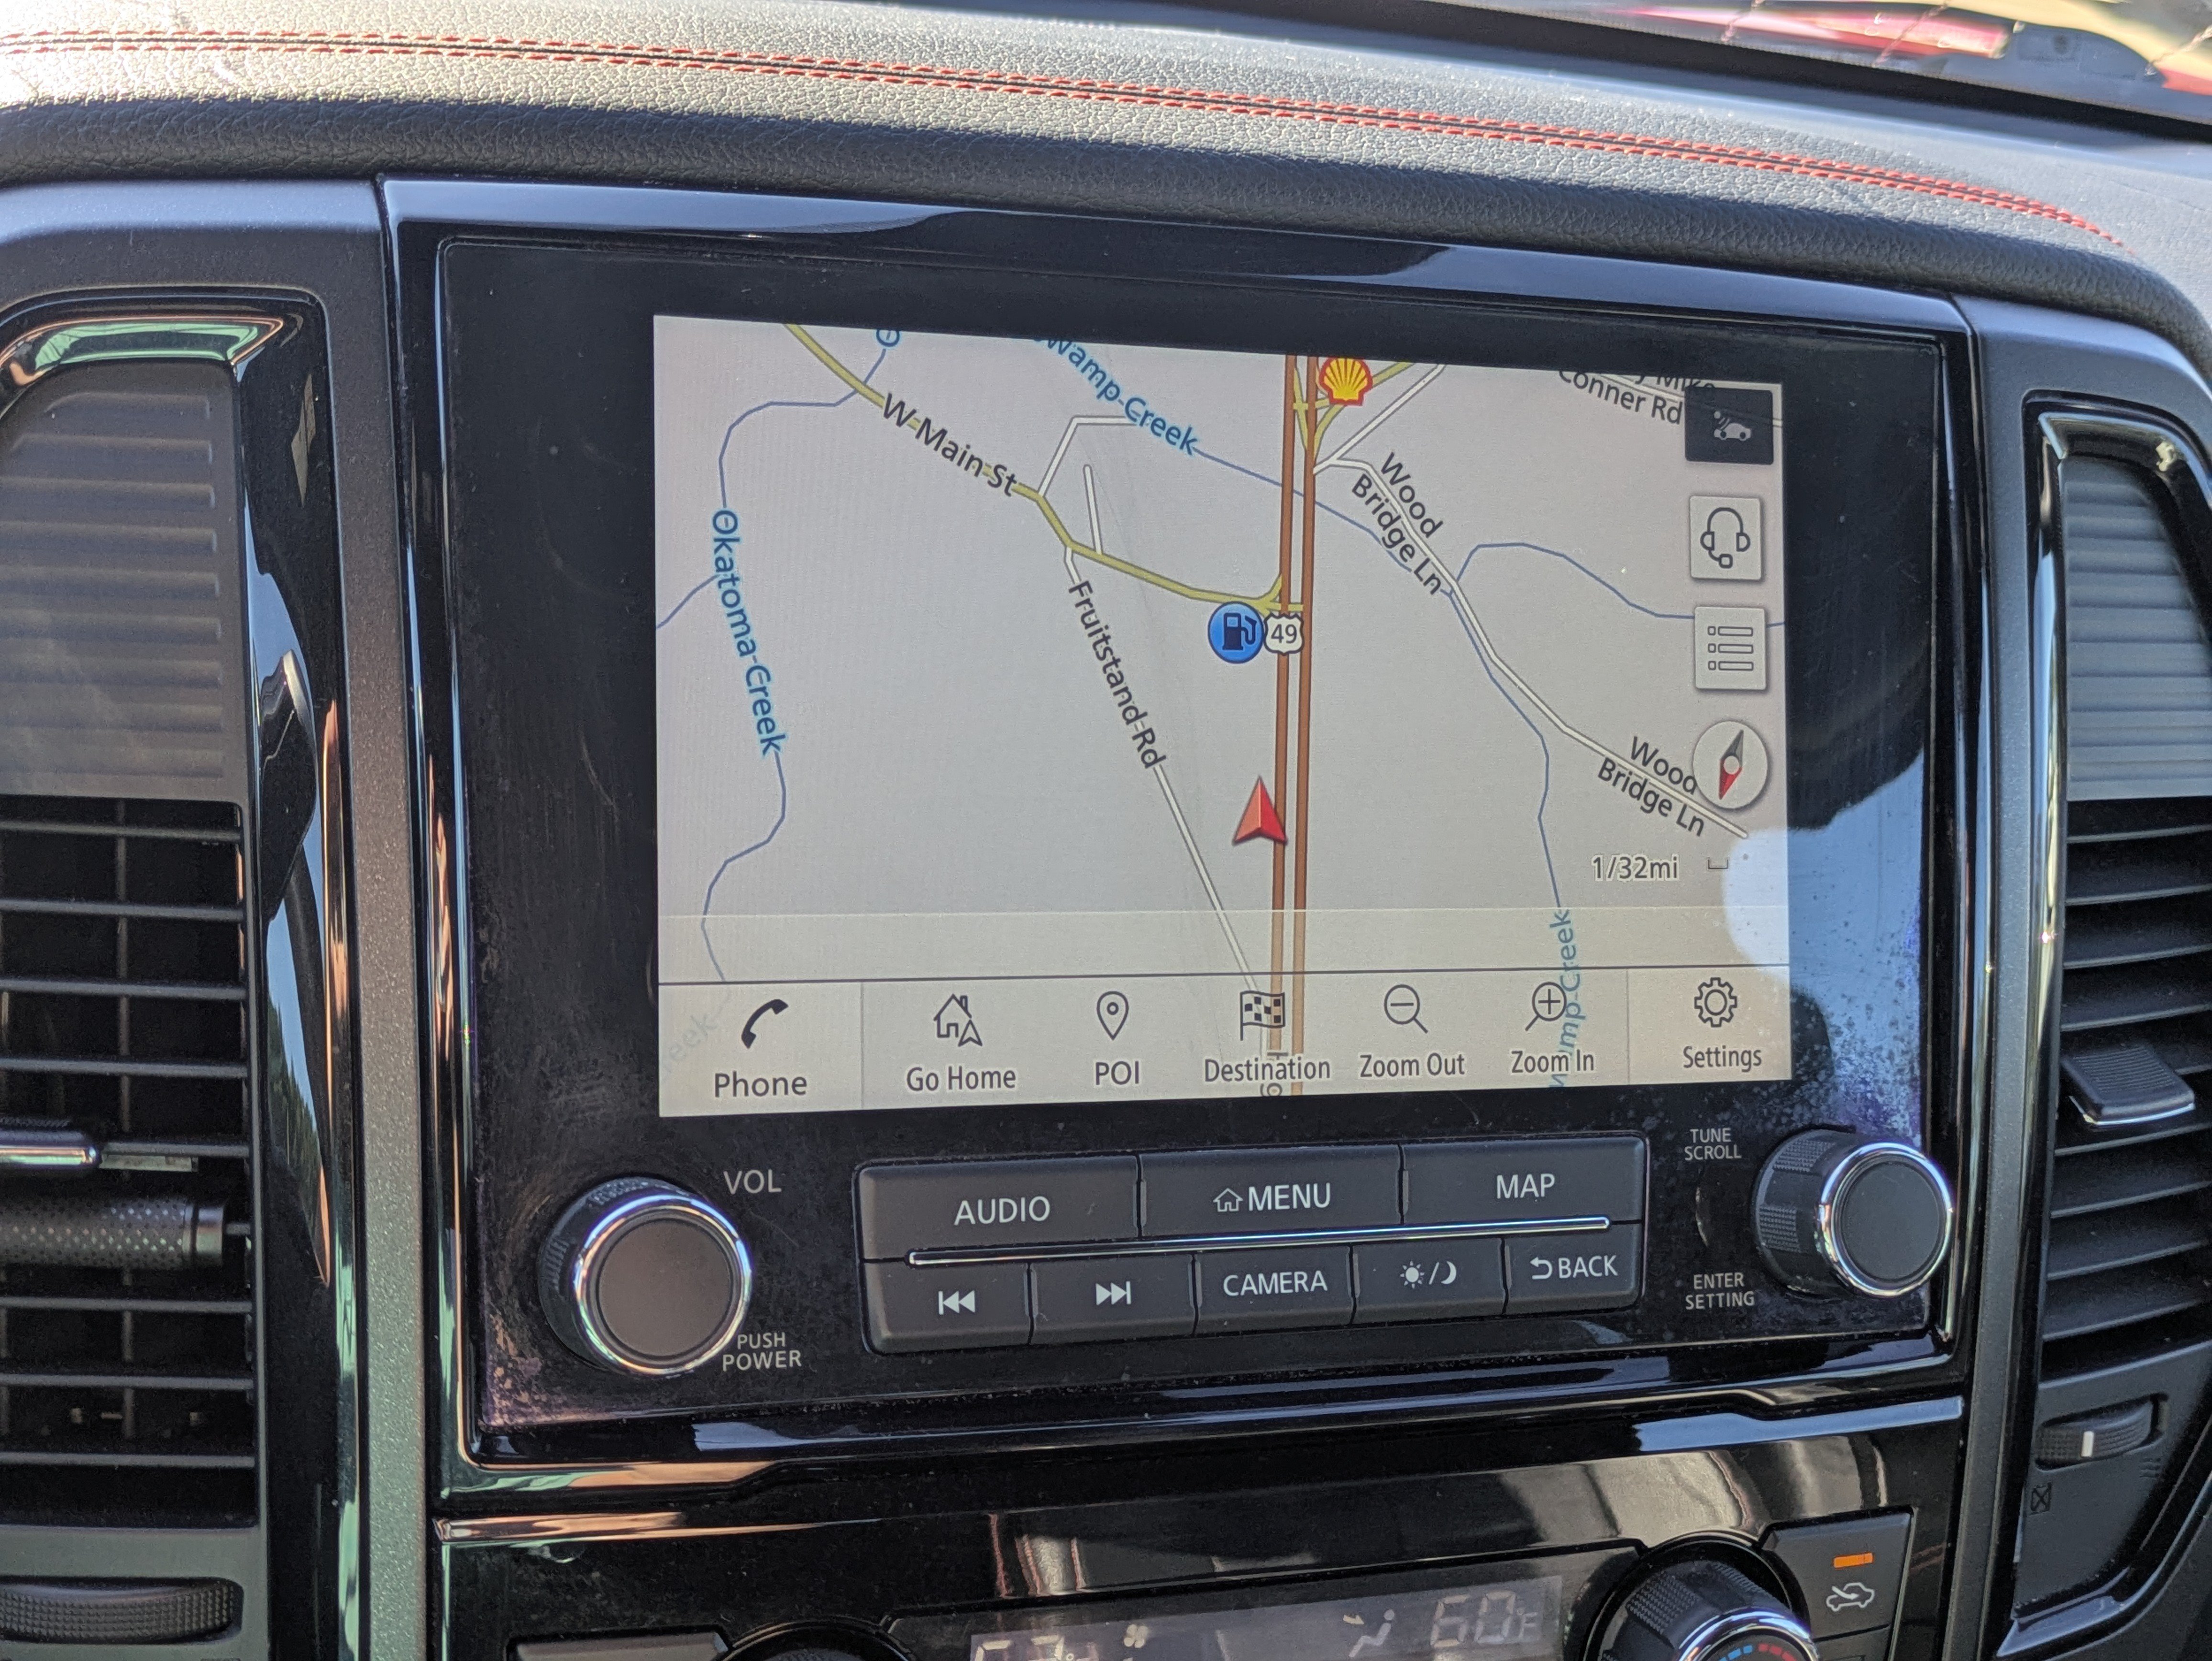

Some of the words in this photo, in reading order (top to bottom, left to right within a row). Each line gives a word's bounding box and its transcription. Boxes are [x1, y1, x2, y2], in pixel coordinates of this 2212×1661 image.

[1038, 339, 1120, 401] wamp
[1124, 397, 1197, 455] Creek
[1652, 395, 1682, 424] Rd
[881, 393, 917, 427] W
[915, 418, 984, 477] Main
[987, 464, 1017, 497] St
[1381, 452, 1443, 538] Wood
[1351, 474, 1416, 562] Bridge
[1413, 558, 1442, 595] Ln
[712, 510, 756, 657] Okatoma
[746, 665, 786, 756] Creek
[1271, 624, 1298, 643] 49
[1068, 580, 1148, 725] Fruitstand
[1131, 727, 1167, 768] Rd
[1598, 757, 1673, 818] Bridge
[1676, 804, 1704, 837] Ln
[1593, 856, 1678, 879] 1/32mi
[1549, 909, 1580, 992] Creek
[1204, 1056, 1331, 1083] Destination
[1360, 1054, 1420, 1079] Zoom
[1427, 1053, 1465, 1077] Out
[1511, 1050, 1569, 1073] Zoom
[1577, 1049, 1594, 1072] In
[1683, 1045, 1762, 1073] Settings
[715, 1070, 808, 1098] Phone
[907, 1066, 939, 1091] Go
[948, 1065, 1017, 1090] Home
[1095, 1061, 1140, 1085] POI
[1690, 1128, 1732, 1144] TUNE
[1685, 1144, 1741, 1161] SCROLL
[723, 1169, 782, 1195] VOL
[1496, 1173, 1556, 1199] MAP
[1248, 1183, 1331, 1211] MENU
[954, 1196, 1051, 1226] AUDIO
[1558, 1255, 1618, 1279] BACK
[1223, 1271, 1328, 1297] CAMERA
[1693, 1273, 1745, 1290] ENTER
[1685, 1290, 1755, 1311] SETTING
[737, 1332, 786, 1350] PUSH
[722, 1350, 802, 1372] POWER
